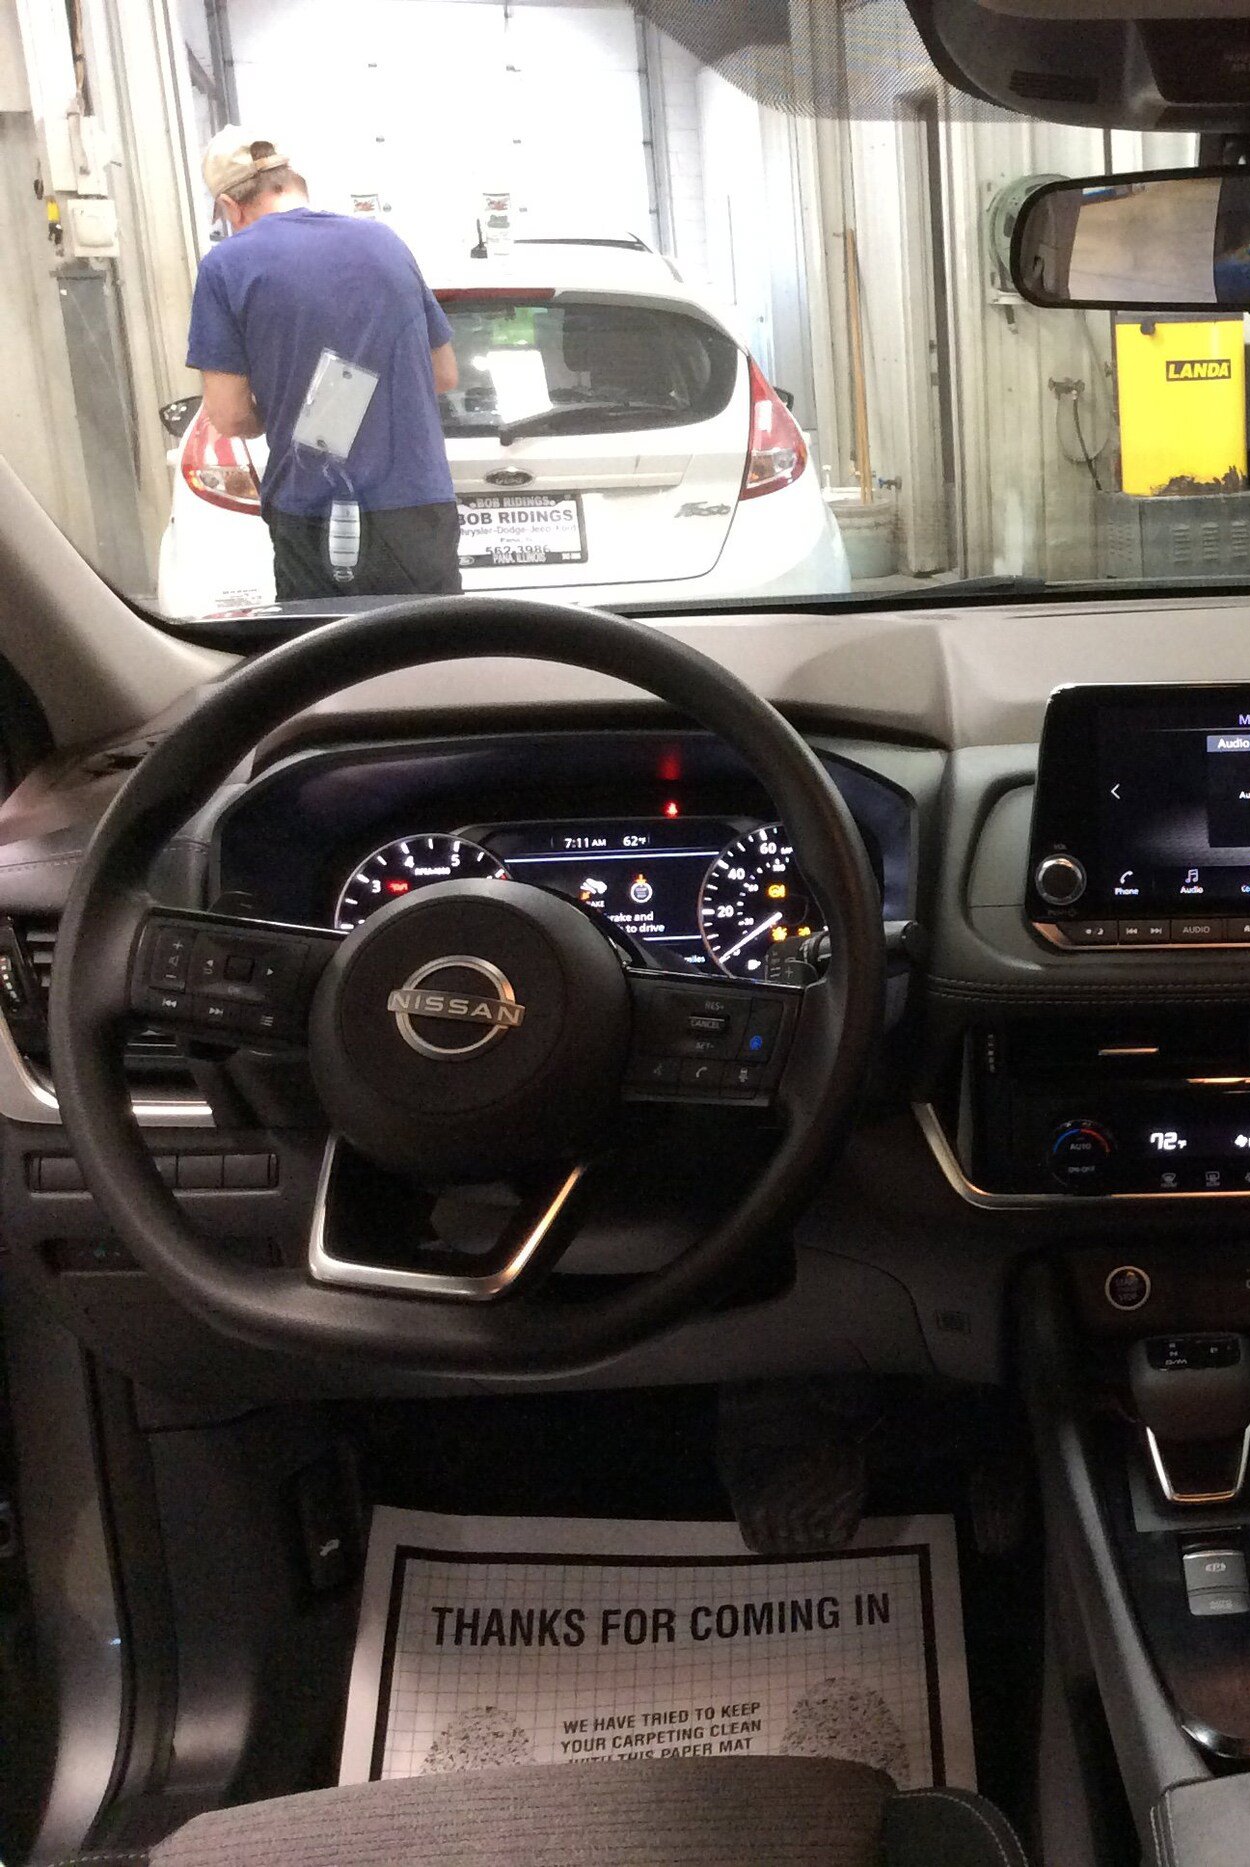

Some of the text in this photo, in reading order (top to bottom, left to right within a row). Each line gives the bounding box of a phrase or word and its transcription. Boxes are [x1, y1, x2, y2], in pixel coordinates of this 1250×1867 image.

[1168, 362, 1229, 379] LANDA
[476, 496, 550, 508] BOB RIDINGS
[498, 510, 574, 524] RIDINGS
[1217, 738, 1250, 749] Audio
[759, 842, 777, 855] 60
[404, 856, 415, 869] 4
[451, 854, 461, 867] 5
[728, 868, 746, 880] 40
[371, 879, 381, 893] 3
[1114, 887, 1139, 896] Phone
[1180, 886, 1204, 894] Audio
[606, 911, 654, 923] rake and
[717, 905, 734, 918] 20
[626, 923, 665, 933] to drive
[1182, 926, 1210, 934] AUDIO
[391, 991, 521, 1025] NISSAN
[691, 1020, 720, 1029] CANCEL
[1069, 1143, 1092, 1151] AUTO
[431, 1592, 891, 1647] THANKS FOR COMING IN
[563, 1701, 761, 1735] WE HAVE TRIED TO KEEP
[561, 1719, 762, 1754] YOUR CARPETING CLEAN
[661, 1743, 713, 1758] PAPER
[719, 1736, 754, 1753] MAT
